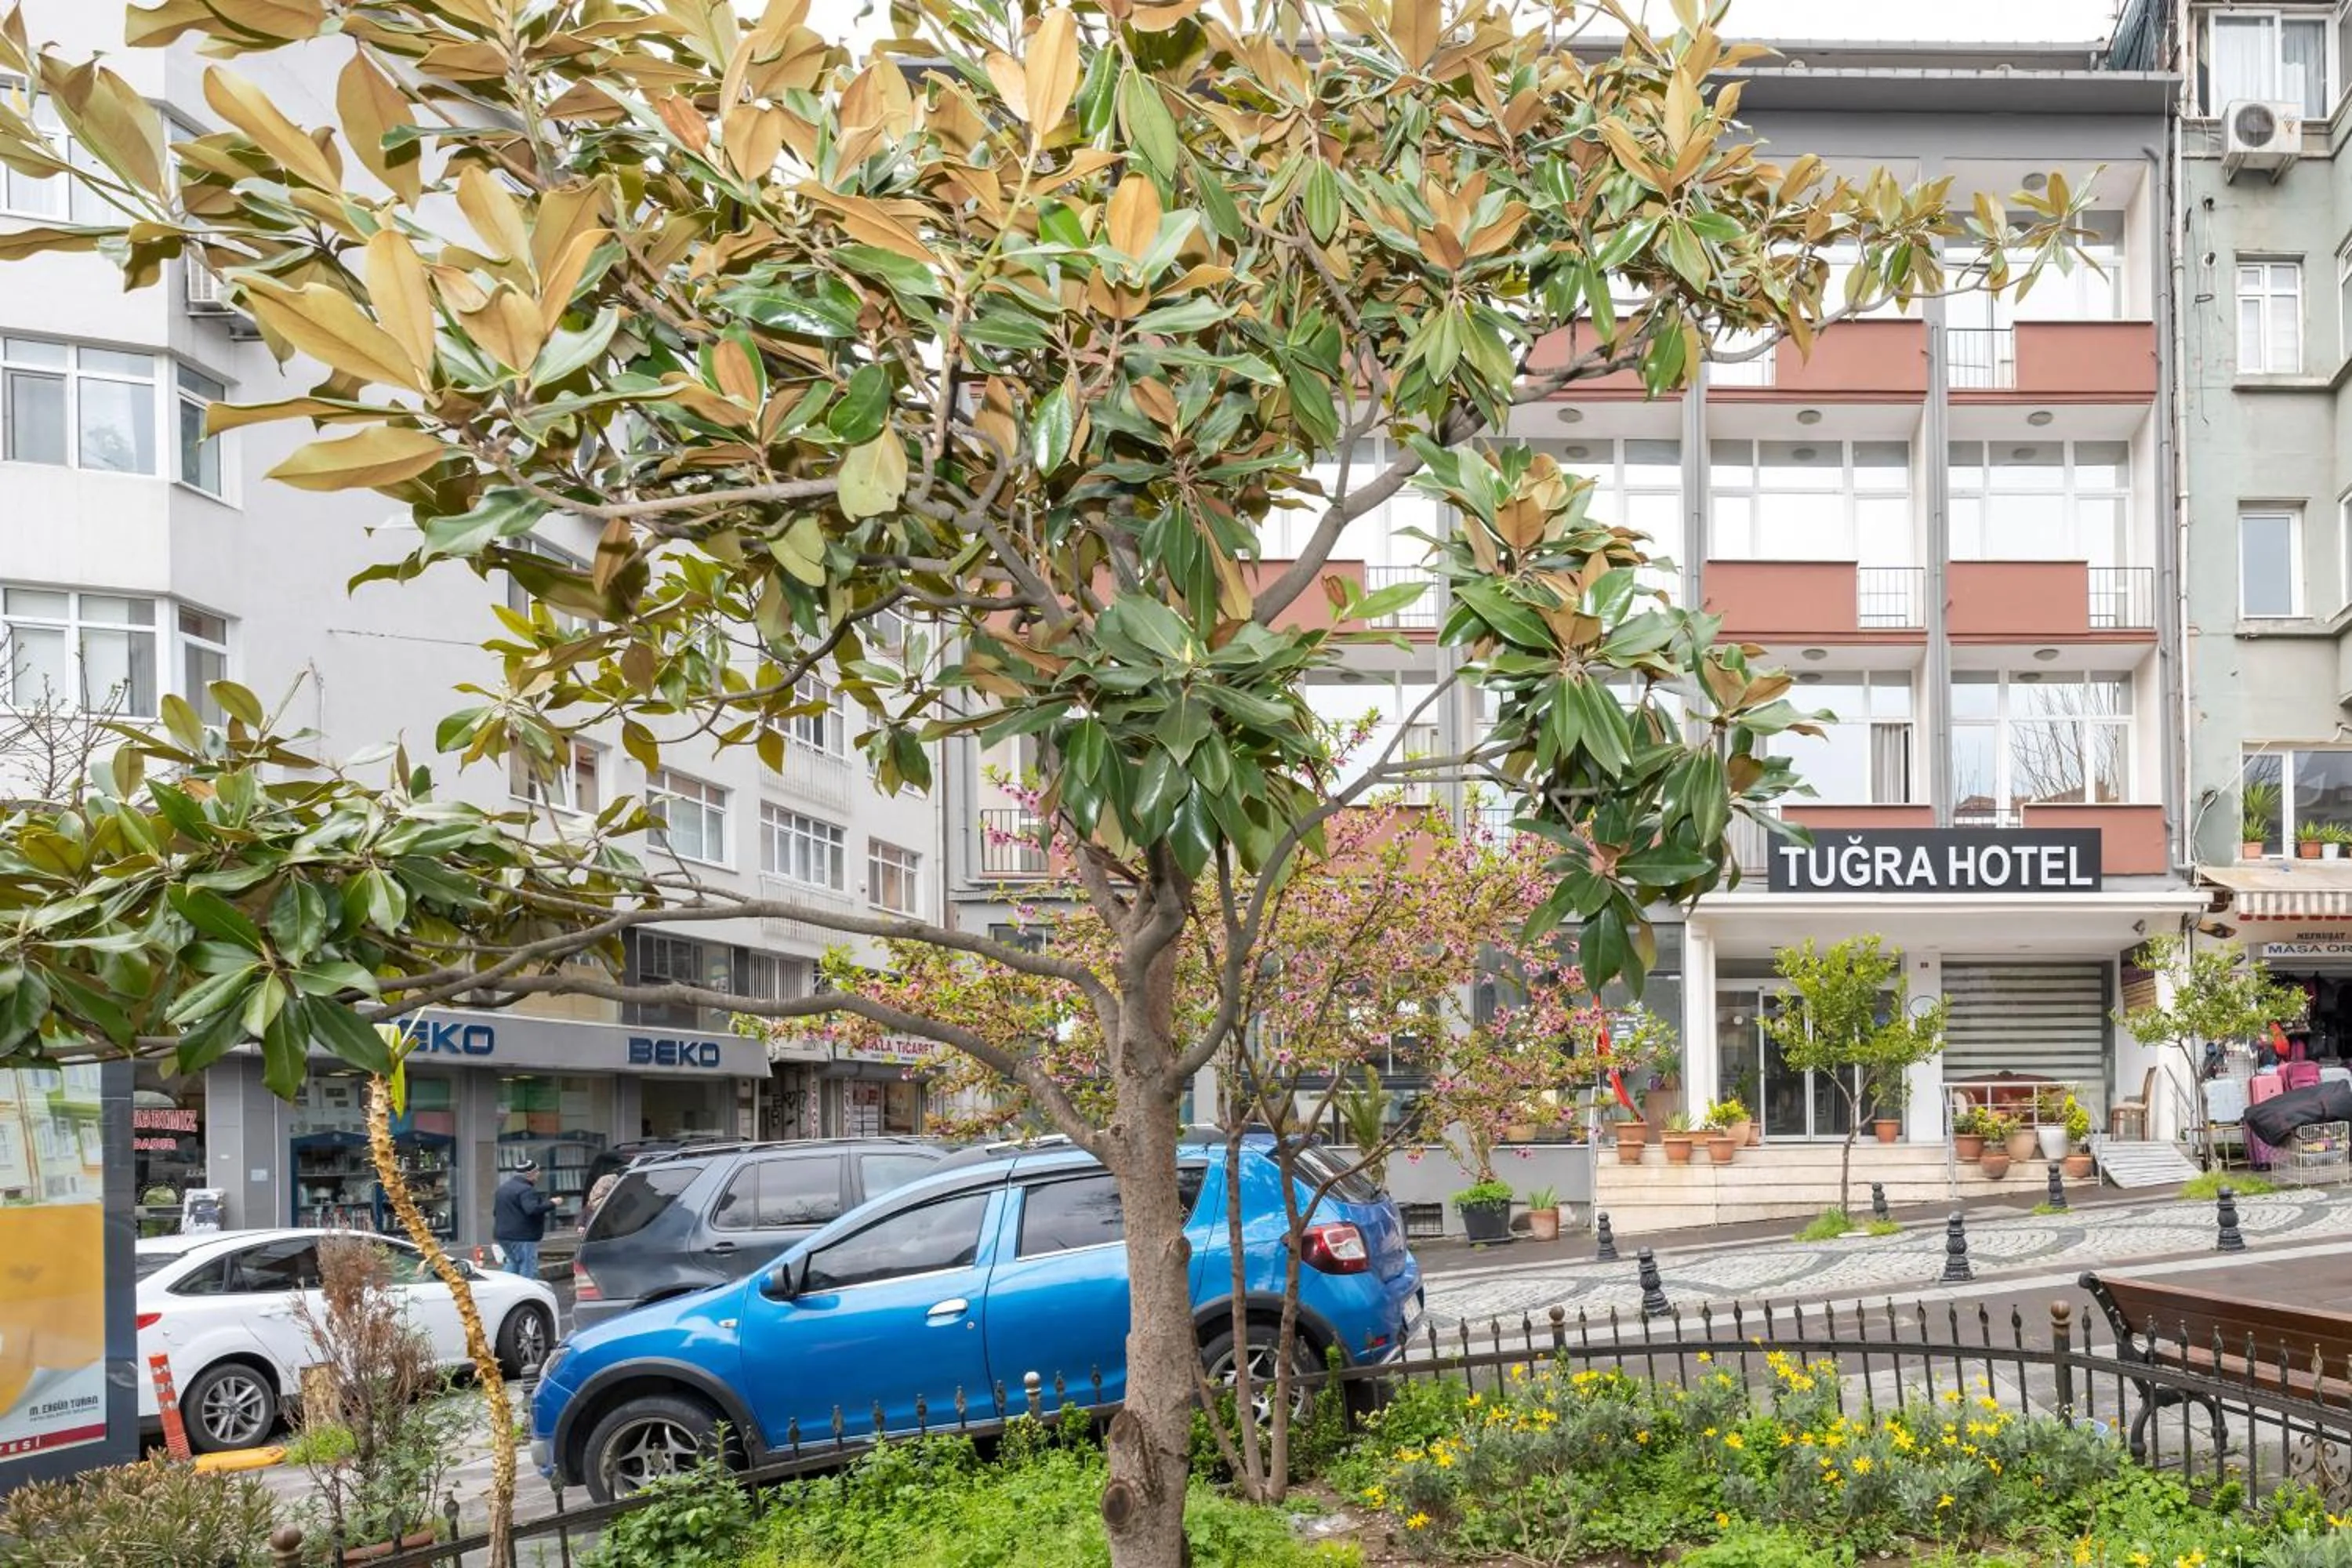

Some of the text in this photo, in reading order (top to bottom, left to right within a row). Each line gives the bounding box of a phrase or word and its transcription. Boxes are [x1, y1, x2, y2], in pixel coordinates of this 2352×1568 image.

[1779, 835, 2093, 887] TUĞRA HOTEL
[2267, 945, 2321, 954] MASA
[398, 1018, 495, 1055] EKO
[628, 1036, 720, 1068] BEKO
